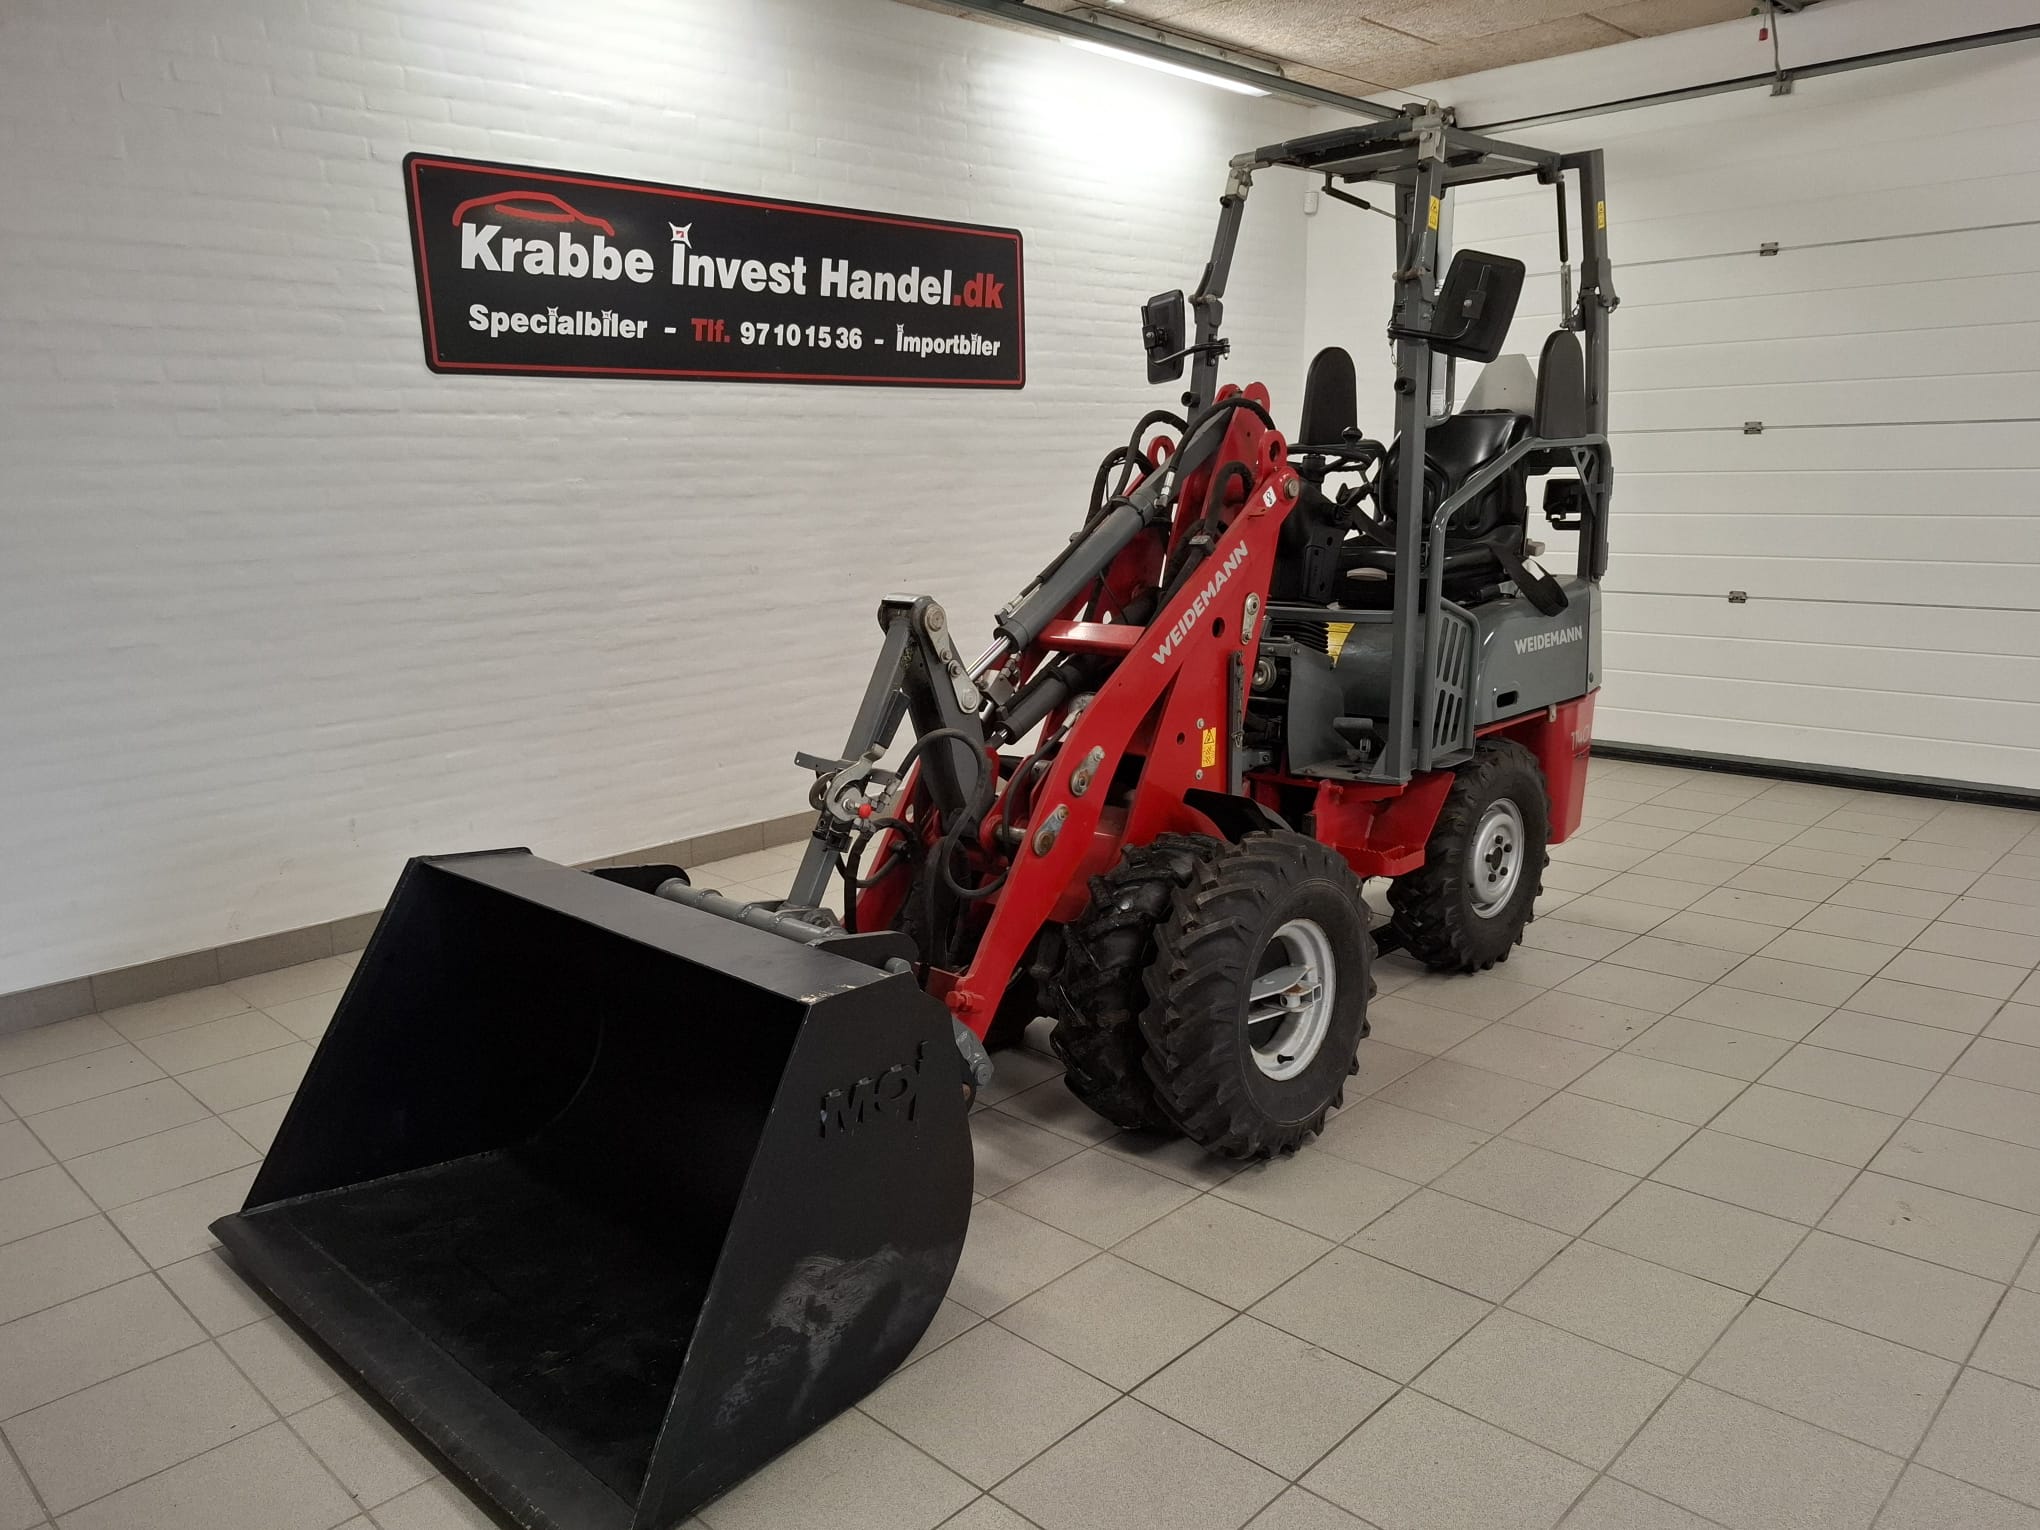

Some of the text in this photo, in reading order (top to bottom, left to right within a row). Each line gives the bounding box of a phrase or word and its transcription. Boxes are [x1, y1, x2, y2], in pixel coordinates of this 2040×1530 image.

[461, 221, 1005, 309] Krabbe Invest Handel.dk
[468, 303, 648, 339] Specialbiler
[691, 317, 731, 343] Tlf.
[896, 324, 1000, 358] Importbiler
[1152, 540, 1248, 665] WEIDEMANN
[1514, 625, 1583, 655] WEIDEMANN
